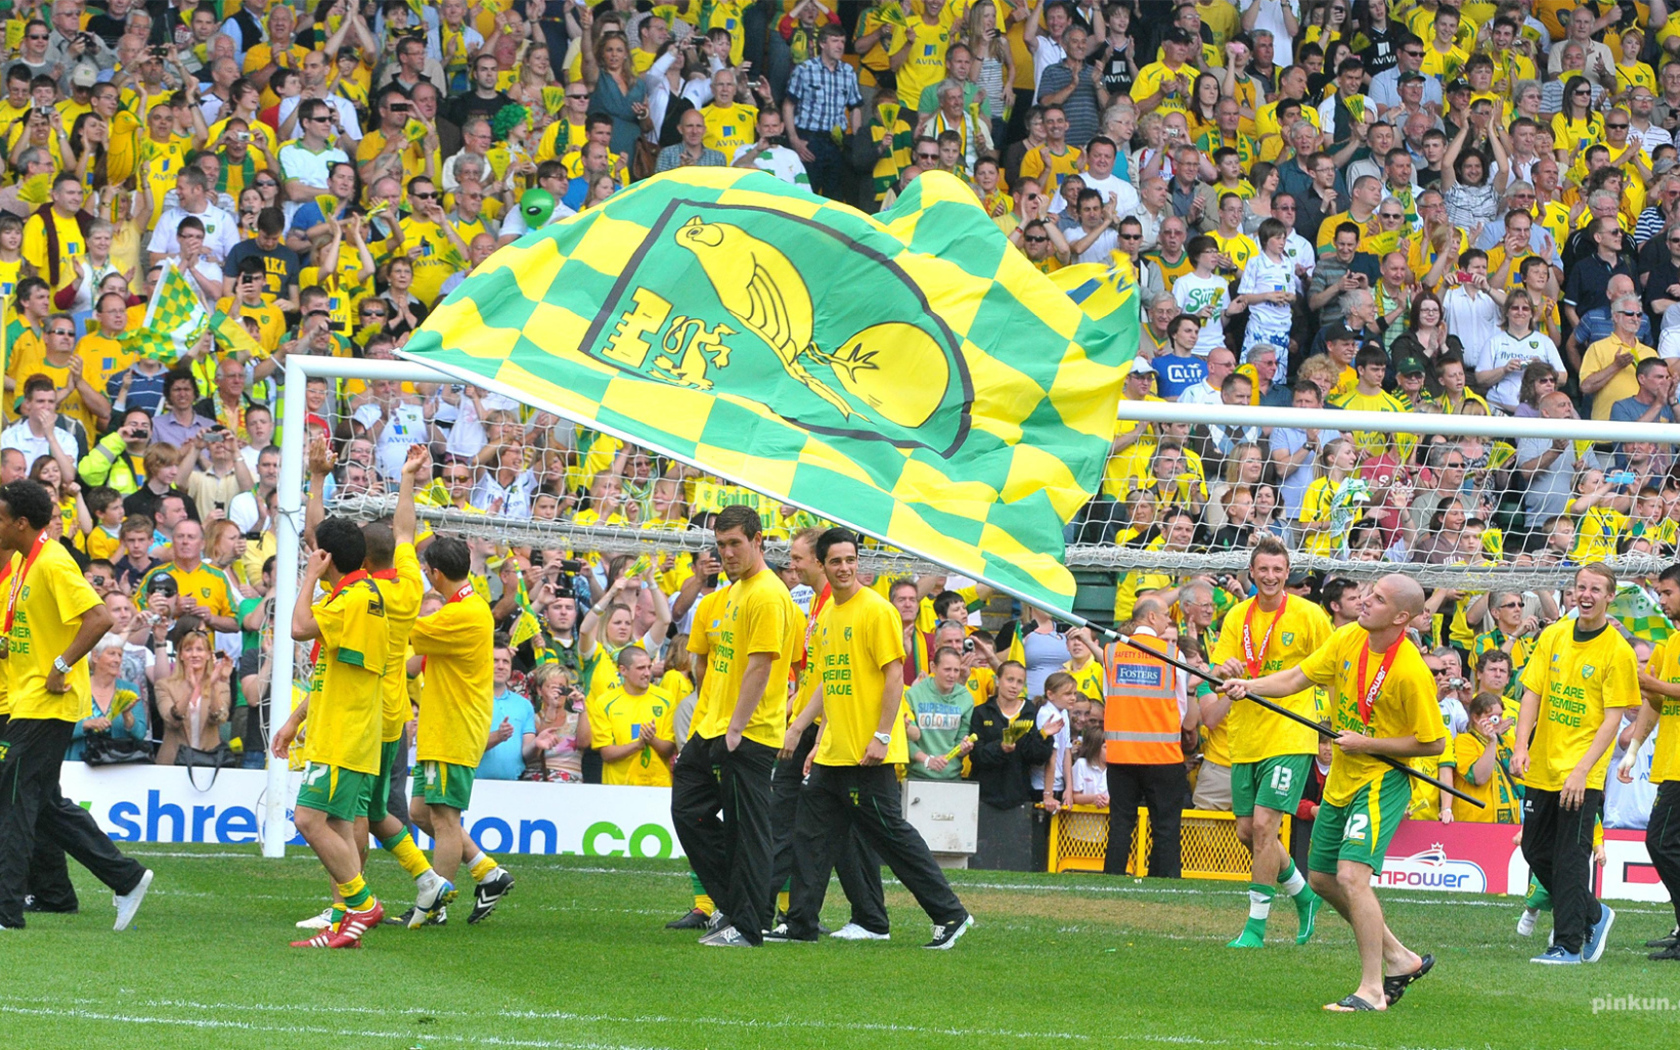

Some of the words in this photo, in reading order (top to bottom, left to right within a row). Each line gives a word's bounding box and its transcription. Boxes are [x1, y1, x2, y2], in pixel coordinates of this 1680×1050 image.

[915, 58, 943, 67] AVIVA
[1372, 55, 1398, 65] AVIVA
[1104, 74, 1131, 84] AVIVA
[1160, 100, 1186, 110] AVIVA
[715, 139, 746, 148] AVIVA
[387, 436, 419, 444] AVIVA
[1114, 651, 1137, 659] SAFETY
[1263, 660, 1283, 671] ARE
[1119, 667, 1159, 679] FOSTERS
[1365, 665, 1386, 707] npower
[1562, 685, 1585, 699] ARE
[1548, 695, 1586, 714] PREMIER
[1547, 709, 1581, 727] LEAGUE
[1270, 765, 1293, 791] 13
[1378, 870, 1470, 888] npower
